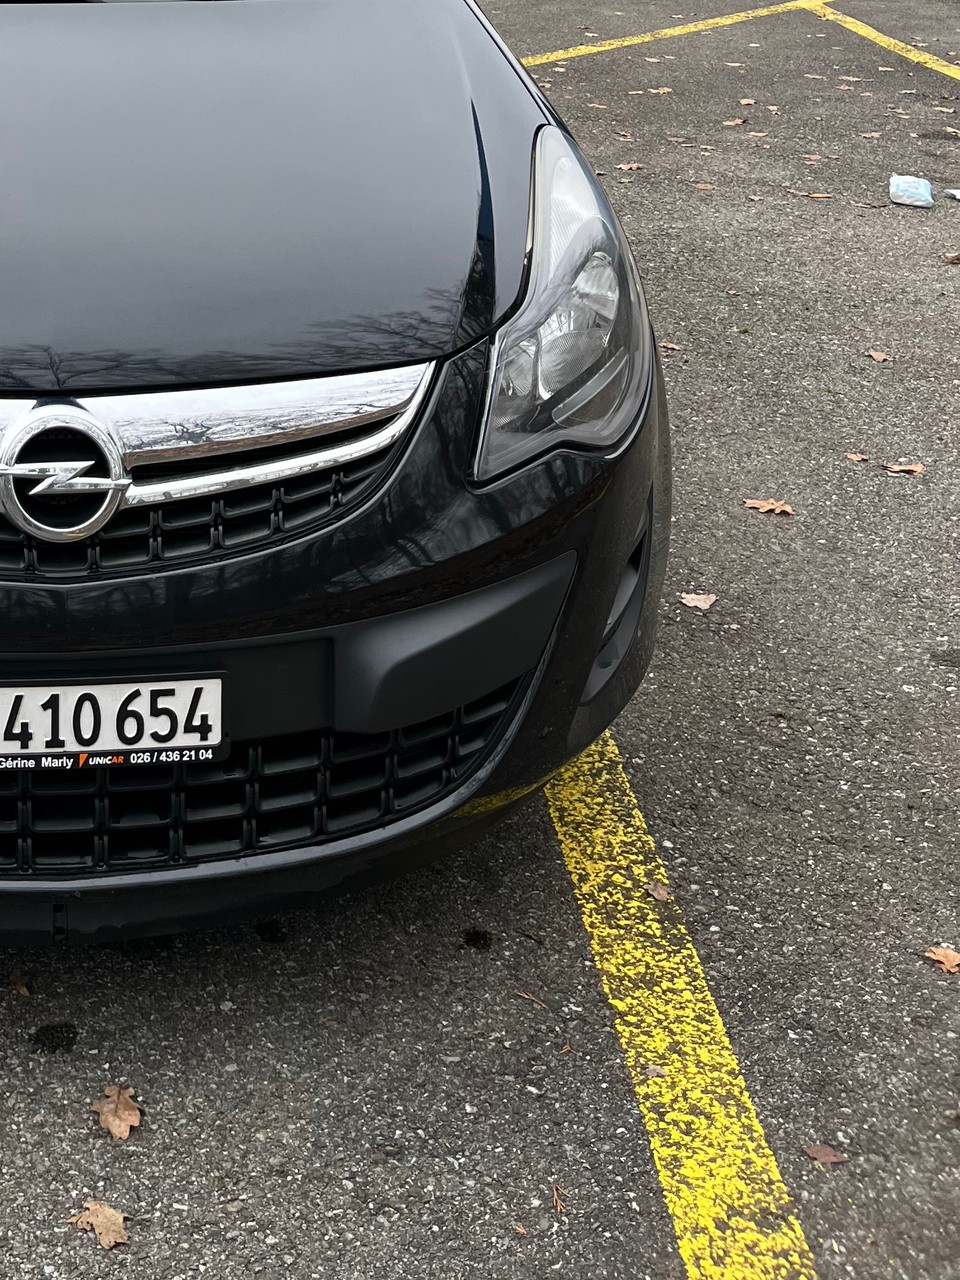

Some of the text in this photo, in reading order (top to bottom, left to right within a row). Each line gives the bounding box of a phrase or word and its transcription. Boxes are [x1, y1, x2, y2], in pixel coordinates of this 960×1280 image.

[41, 756, 74, 769] Marly
[130, 753, 151, 763] 026
[153, 753, 157, 763] /
[159, 751, 180, 762] 436
[182, 750, 196, 761] 21
[198, 749, 213, 760] 04
